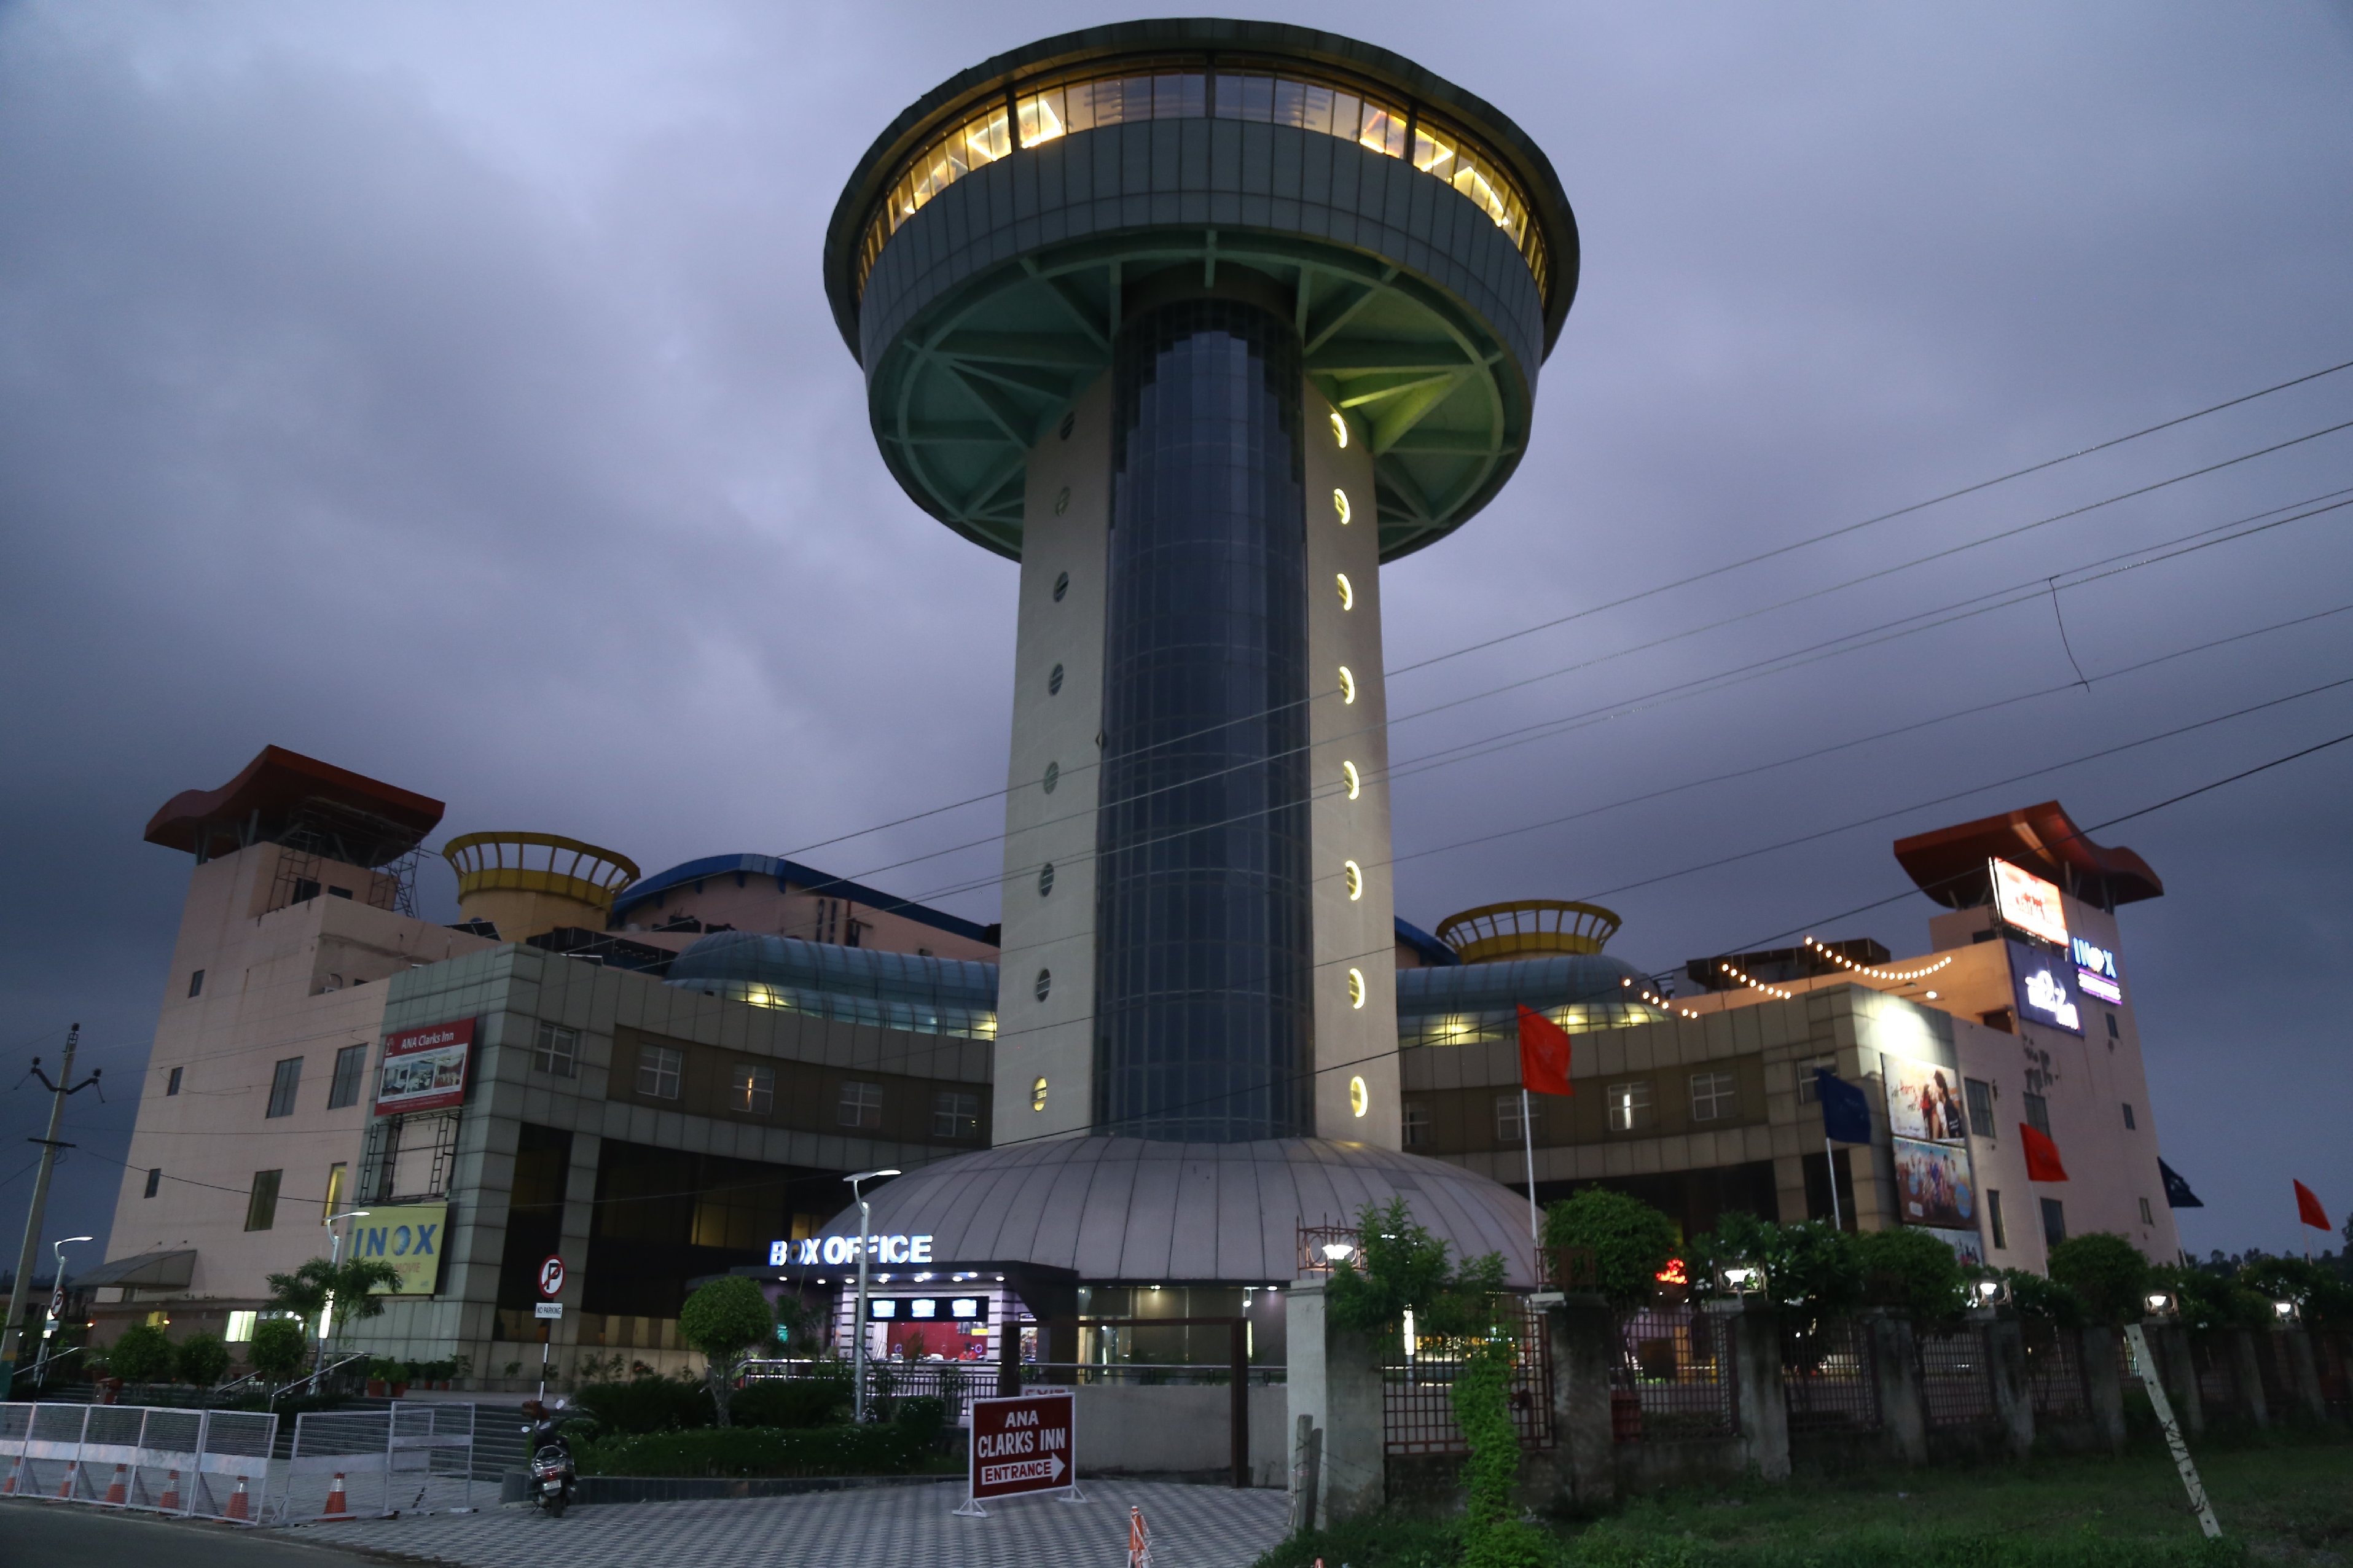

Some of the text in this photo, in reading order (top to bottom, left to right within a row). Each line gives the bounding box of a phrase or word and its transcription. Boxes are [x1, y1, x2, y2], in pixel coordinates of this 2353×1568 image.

[2072, 936, 2117, 979] INOX
[402, 1032, 454, 1049] ANA Clarks Inn
[353, 1224, 437, 1257] INOX
[769, 1238, 821, 1266] BOX
[1004, 1410, 1039, 1428] ANA
[977, 1427, 1065, 1458] CLARKS INN
[984, 1461, 1052, 1482] ENTRANCE
